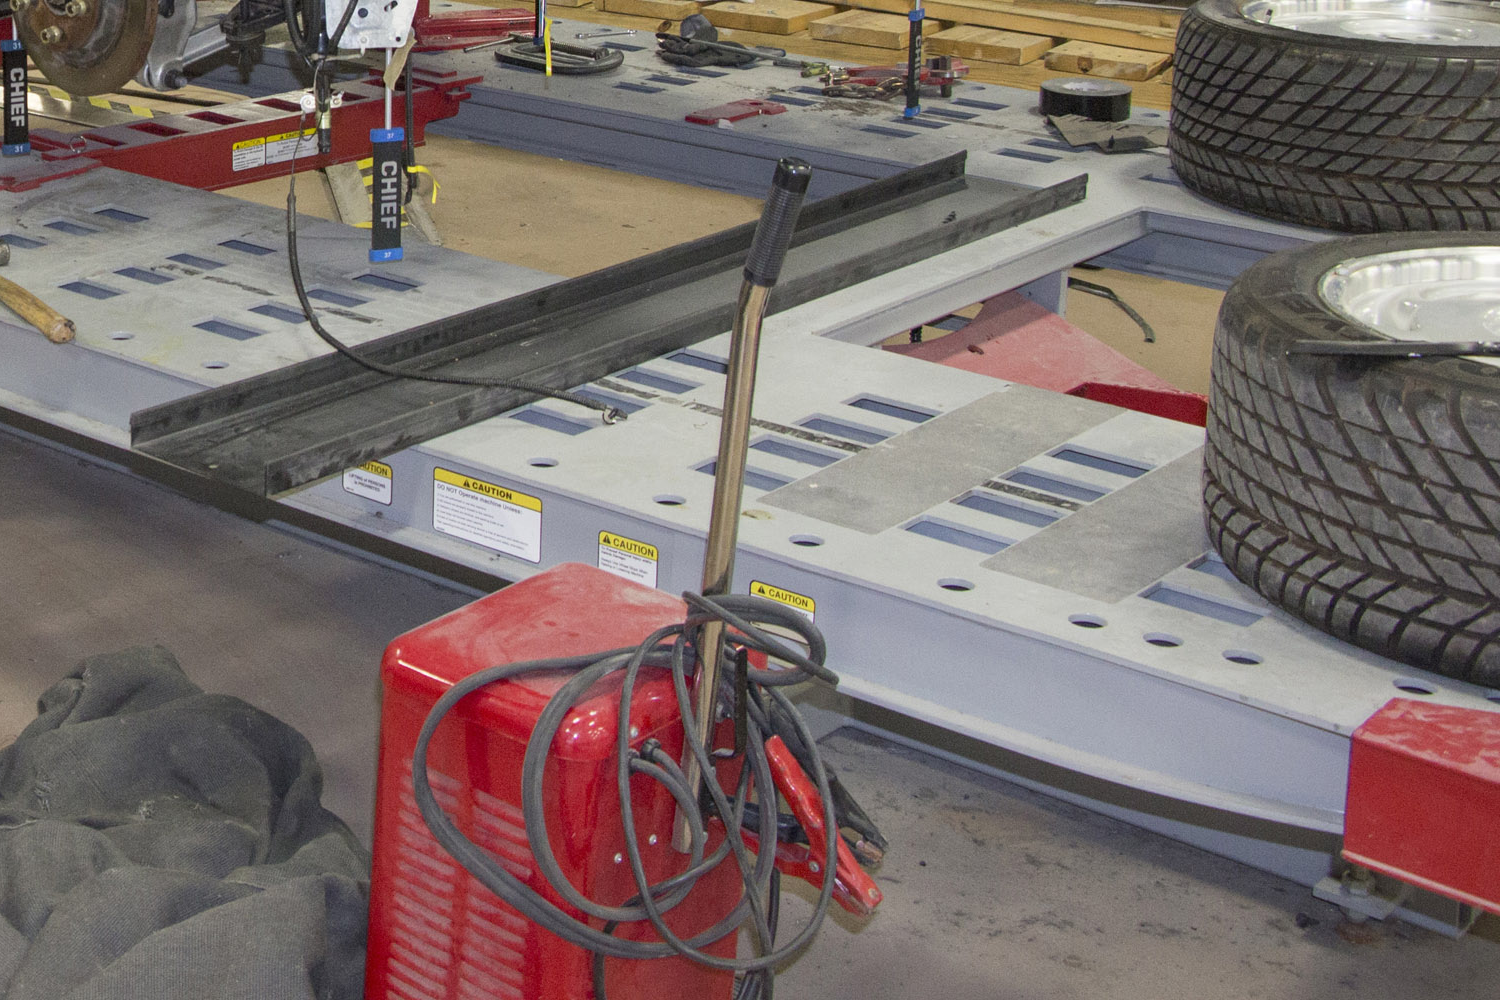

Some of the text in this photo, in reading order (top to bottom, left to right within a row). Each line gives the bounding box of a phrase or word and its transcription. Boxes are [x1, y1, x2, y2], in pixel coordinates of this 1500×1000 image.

[13, 41, 22, 50] 31
[10, 67, 25, 127] CHIEF
[14, 145, 23, 153] 31
[380, 160, 398, 229] CHIEF
[384, 251, 392, 259] 37
[359, 461, 388, 476] AUTION
[437, 482, 445, 491] DO
[446, 485, 458, 495] NOT
[458, 490, 479, 502] Operate
[480, 496, 502, 508] machine
[472, 481, 513, 501] CAUTION
[613, 537, 654, 558] CAUTION
[768, 587, 809, 608] CAUTION
